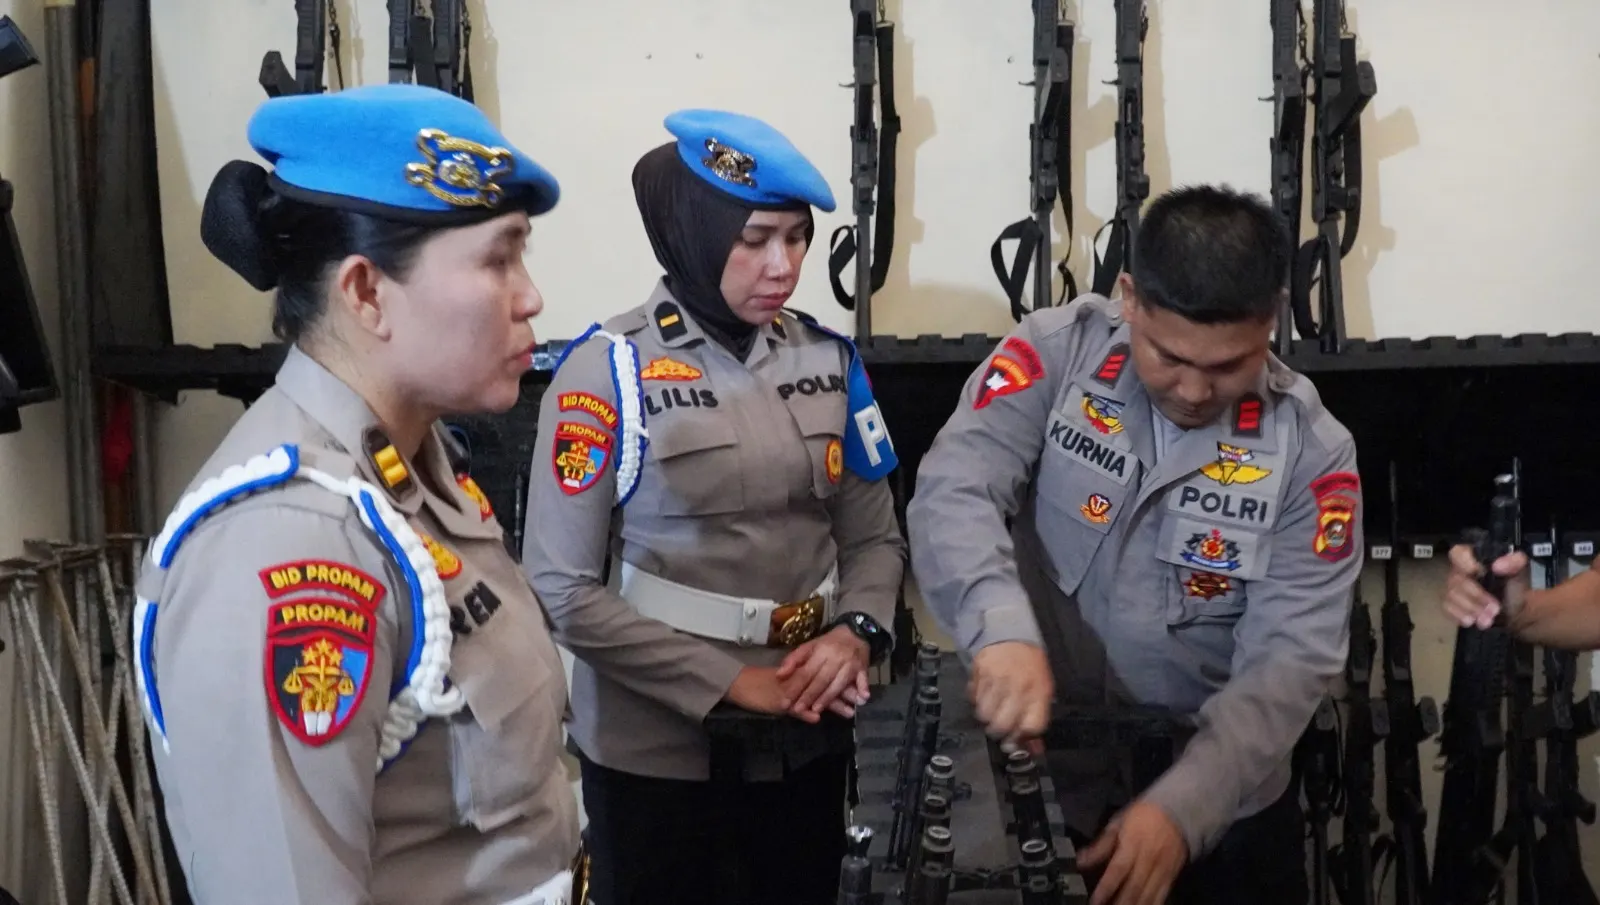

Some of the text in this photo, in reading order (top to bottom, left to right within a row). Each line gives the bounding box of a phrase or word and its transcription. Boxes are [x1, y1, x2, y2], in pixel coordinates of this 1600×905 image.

[645, 387, 719, 416] LILIS
[777, 374, 848, 400] POLRI
[562, 395, 617, 425] BID PROPAM
[563, 423, 606, 444] PROPAM
[854, 400, 894, 467] P
[1049, 420, 1126, 478] KURNIA
[1178, 485, 1269, 523] POLRI
[270, 564, 376, 601] BID PROPAM
[281, 603, 366, 633] PROPAM
